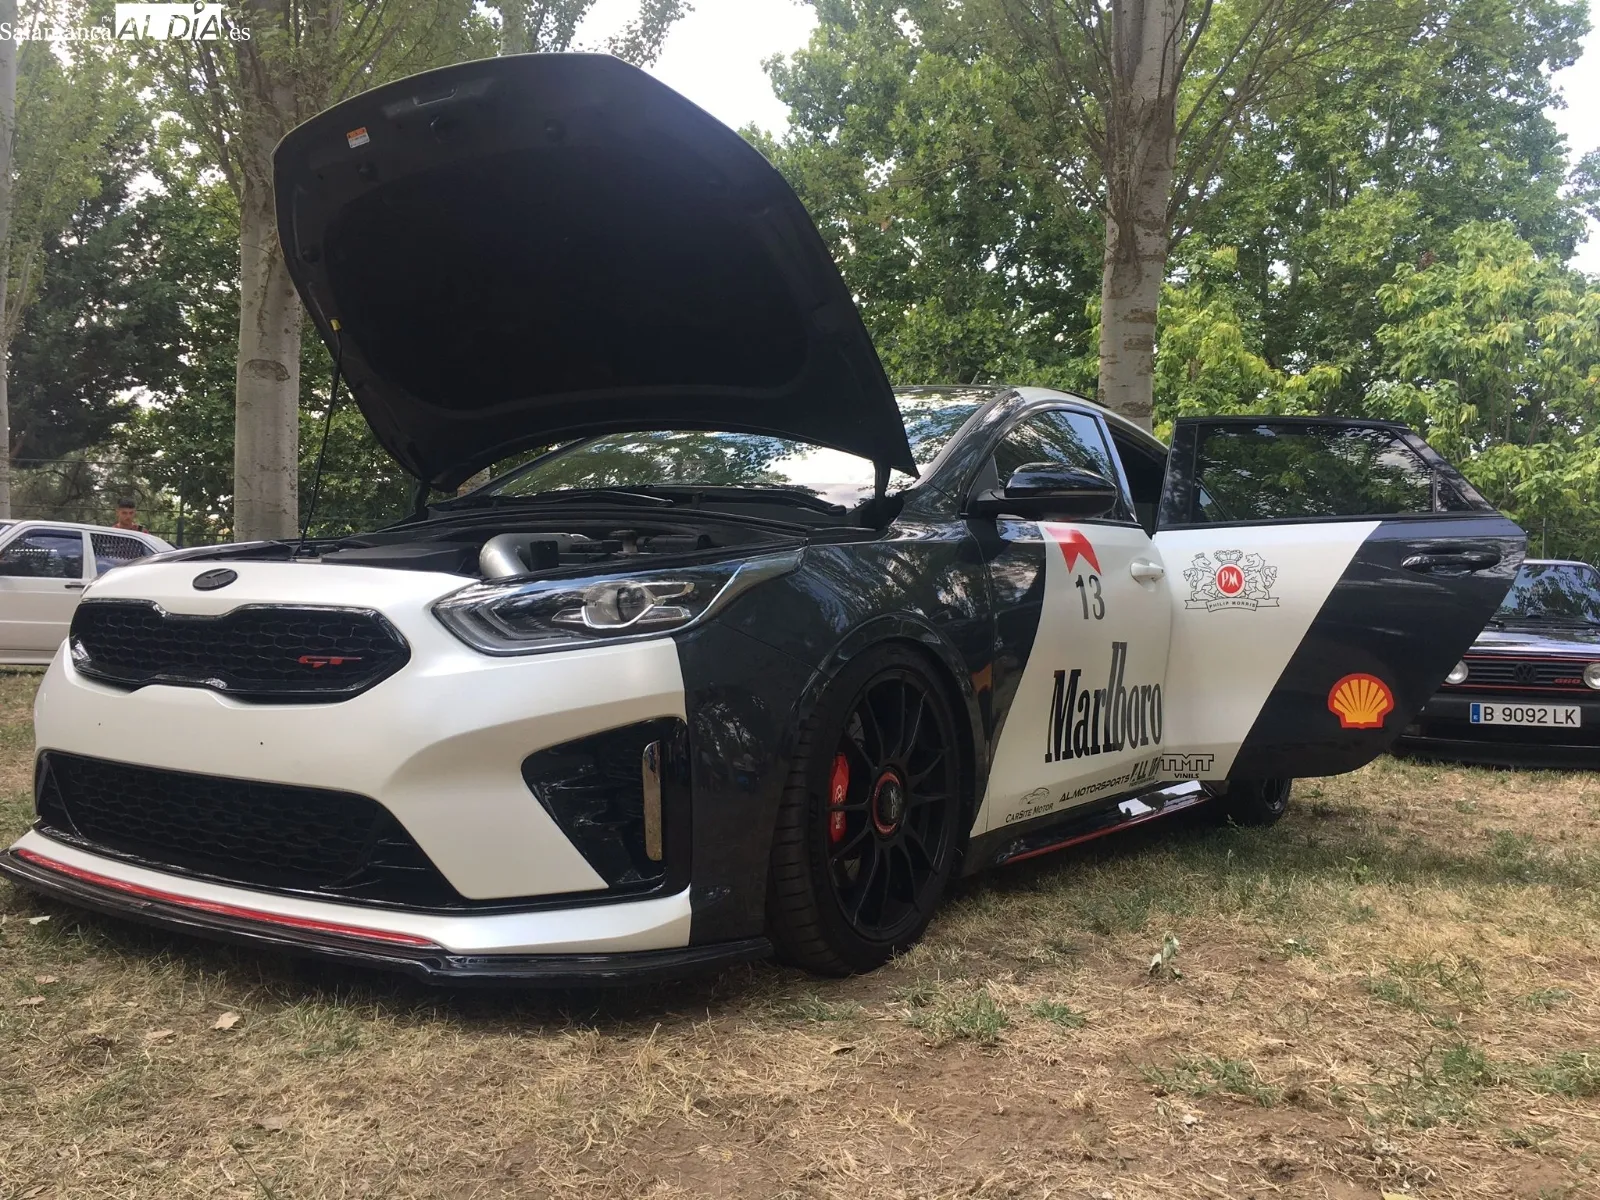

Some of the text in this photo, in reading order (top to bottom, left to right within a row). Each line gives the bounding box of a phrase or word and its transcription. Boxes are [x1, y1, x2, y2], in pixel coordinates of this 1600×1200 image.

[1221, 570, 1239, 588] PM
[1075, 574, 1105, 620] 13
[1045, 641, 1163, 763] Marlboro
[1483, 706, 1576, 725] B 9092 LK
[1162, 753, 1215, 772] TMT
